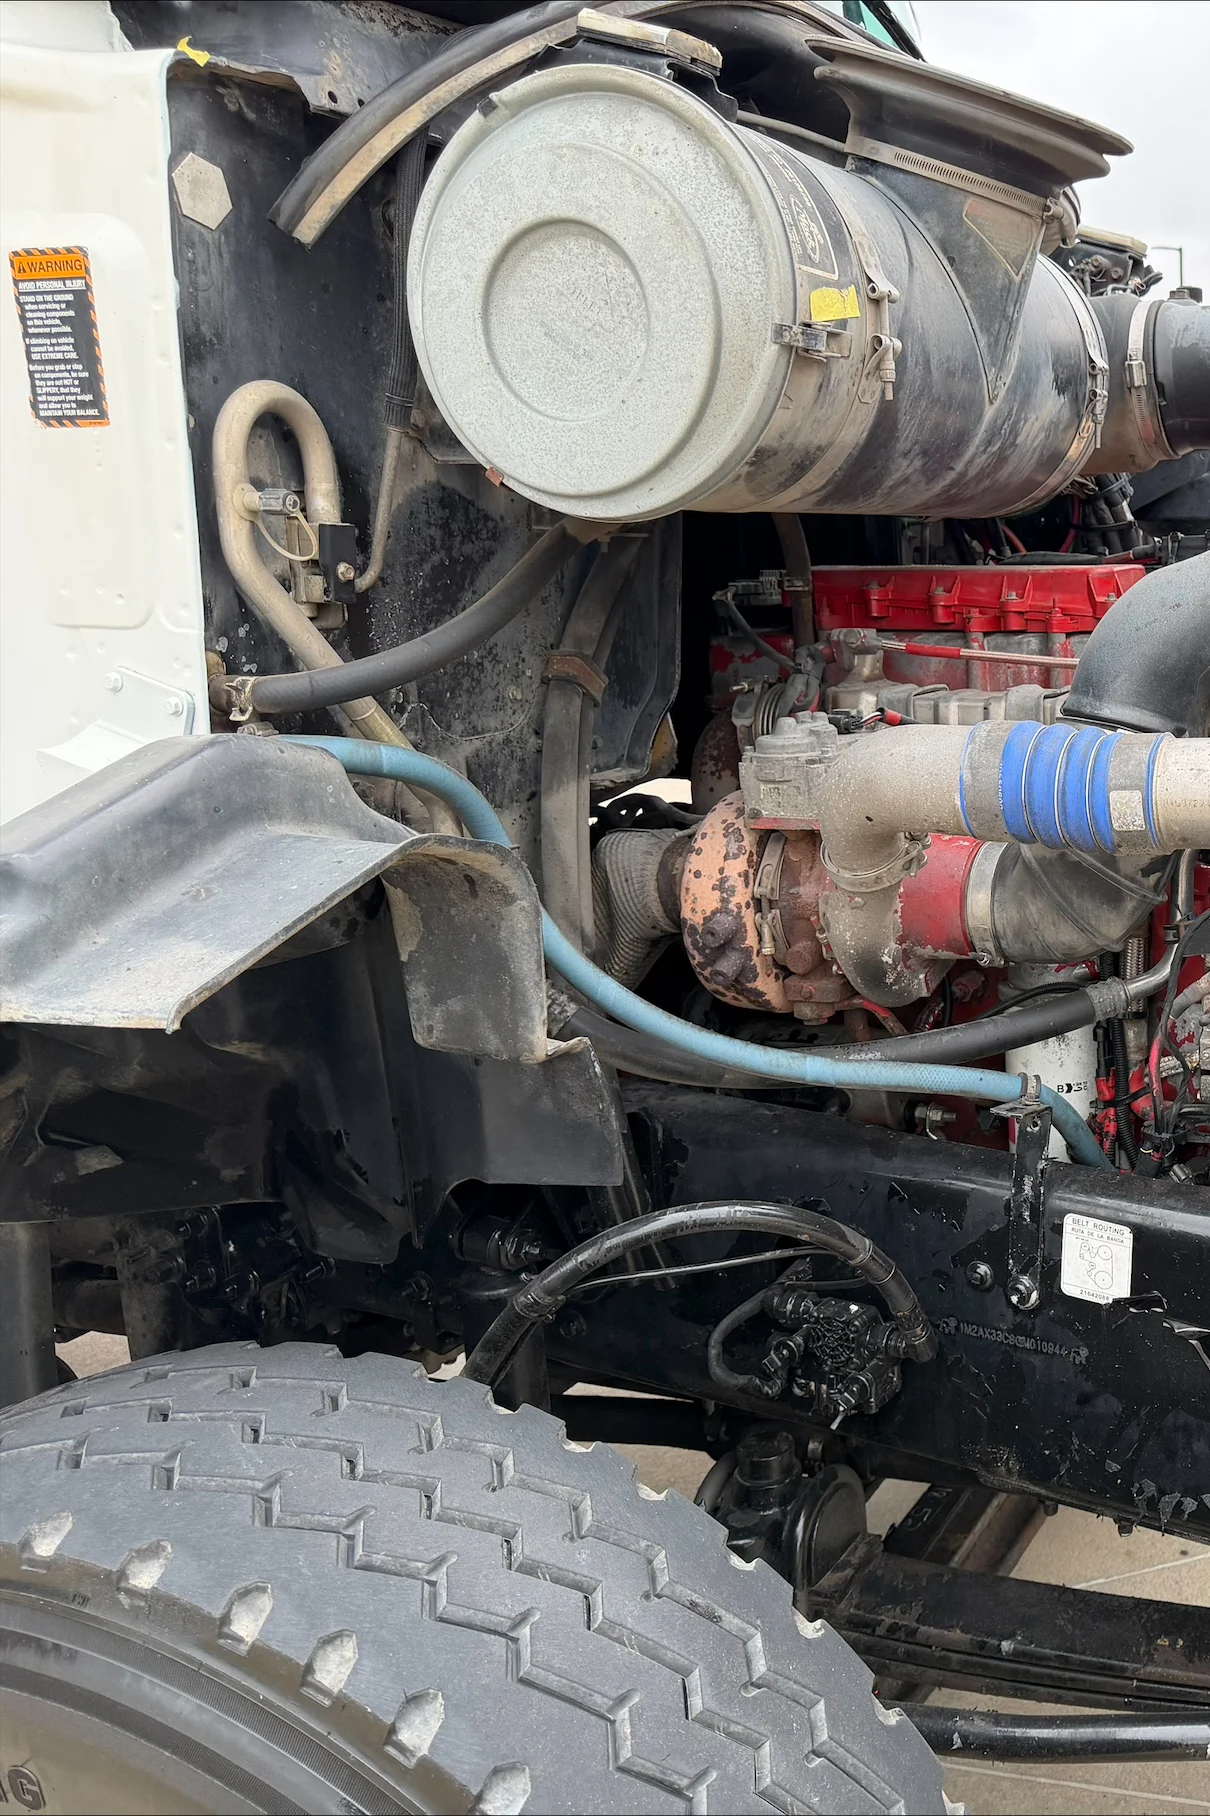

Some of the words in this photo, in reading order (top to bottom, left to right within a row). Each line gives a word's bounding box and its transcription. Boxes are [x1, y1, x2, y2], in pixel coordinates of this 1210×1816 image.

[27, 259, 83, 273] WARNING
[19, 281, 35, 289] AVOID
[36, 280, 65, 289] PERSONAL
[65, 279, 86, 288] INJURY
[46, 310, 75, 318] components
[1072, 1218, 1088, 1227] BELT
[1093, 1222, 1124, 1236] ROUTING
[1106, 1236, 1124, 1244] BANDA
